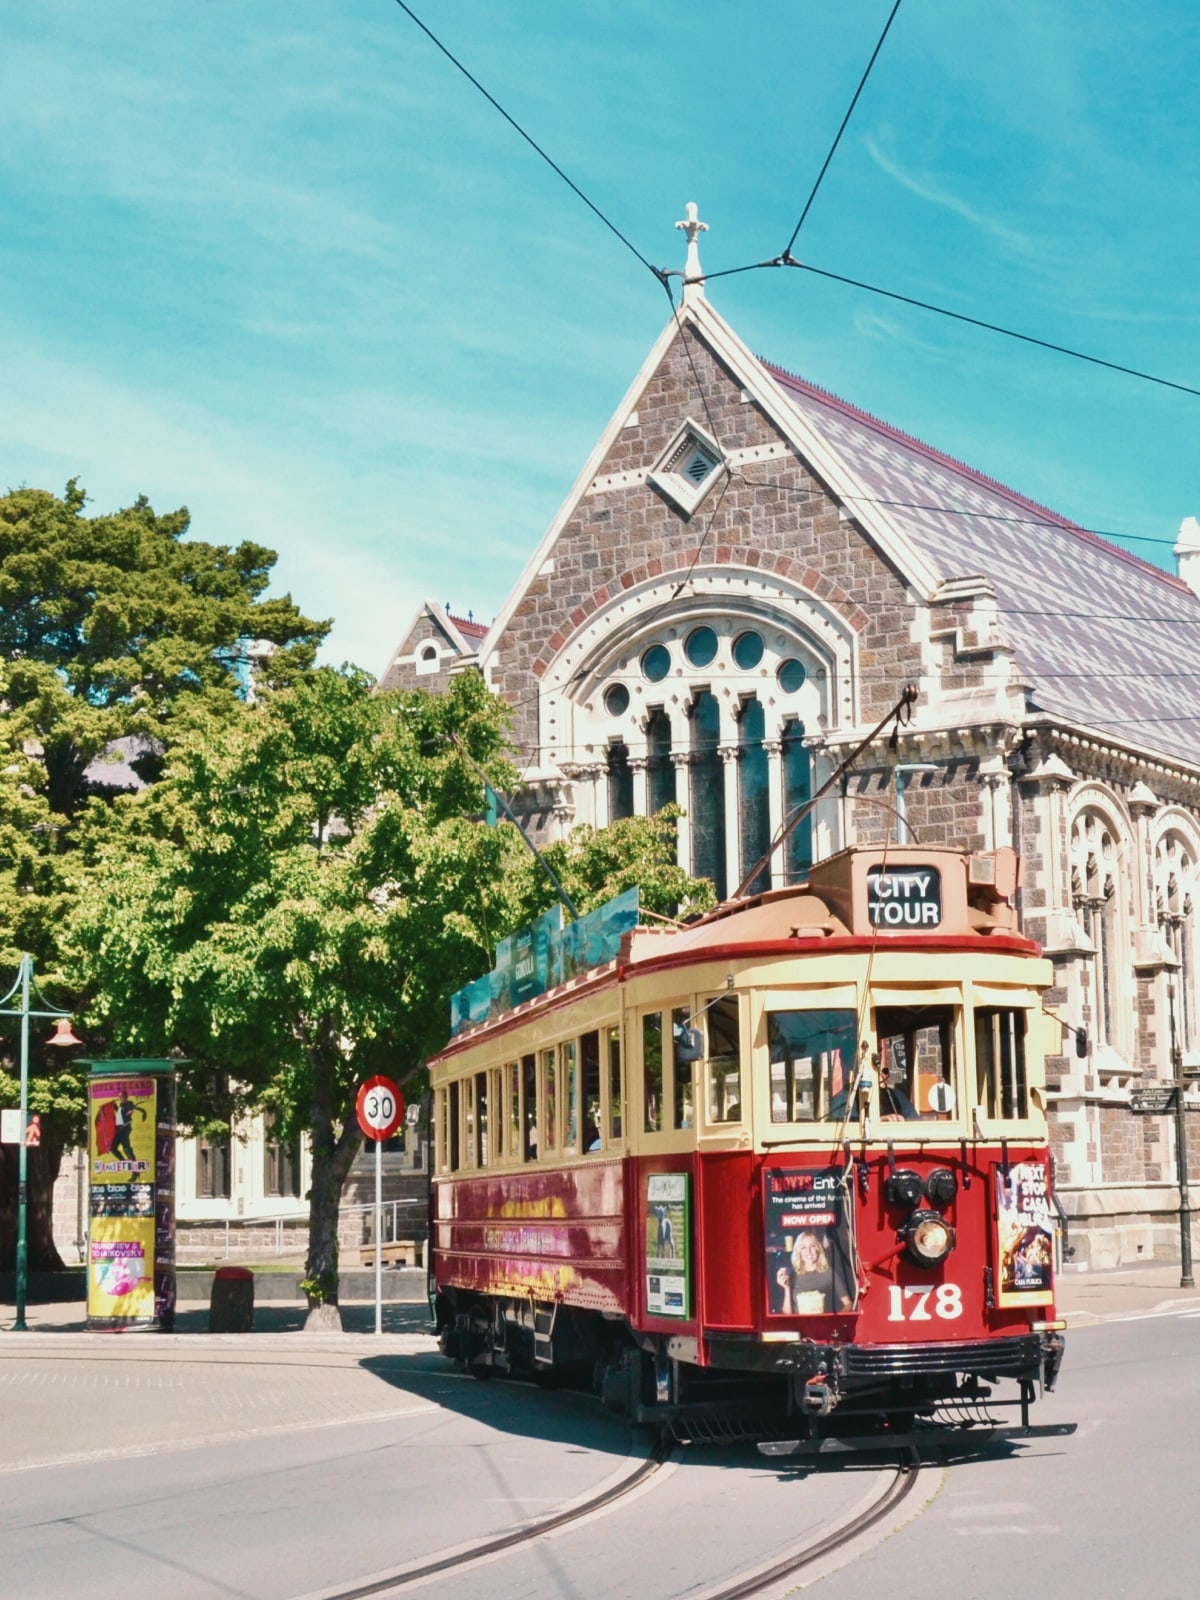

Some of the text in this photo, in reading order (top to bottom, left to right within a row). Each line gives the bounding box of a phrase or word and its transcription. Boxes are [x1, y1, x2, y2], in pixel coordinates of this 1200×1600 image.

[873, 876, 931, 898] CITY
[868, 902, 939, 924] TOUR
[367, 1096, 393, 1119] 30
[1020, 1166, 1045, 1180] NEXT
[1022, 1182, 1046, 1195] STOP
[772, 1196, 783, 1204] The
[808, 1194, 815, 1202] of
[1023, 1197, 1049, 1211] CASA
[783, 1214, 835, 1225] NOW OPEN
[888, 1283, 963, 1321] 178
